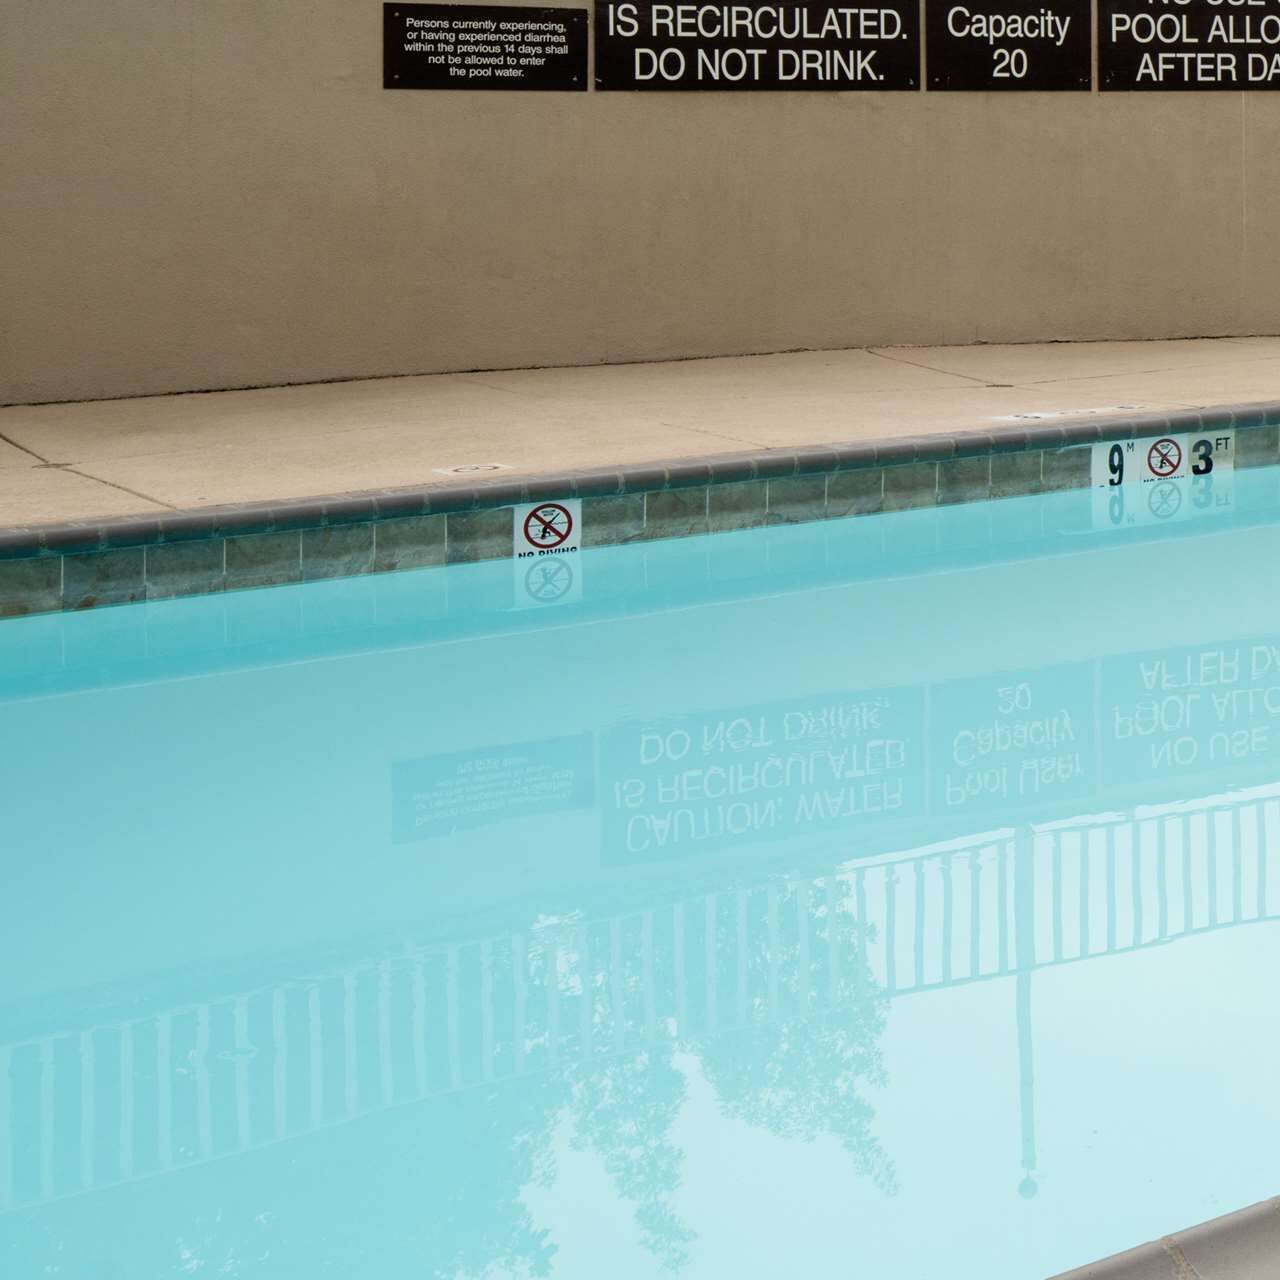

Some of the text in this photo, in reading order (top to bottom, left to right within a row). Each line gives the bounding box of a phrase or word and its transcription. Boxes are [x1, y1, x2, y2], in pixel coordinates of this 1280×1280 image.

[406, 17, 567, 33] Persons currently experiencing,
[608, 4, 908, 39] IS RECIRCULATED.
[947, 6, 1071, 46] Capacity
[1111, 13, 1199, 43] POOL
[404, 41, 568, 56] within the previous 14 days shall
[406, 30, 566, 43] or having experienced diarrhea
[428, 54, 546, 65] not be allowed to enter
[449, 66, 525, 78] the pool water.
[635, 48, 884, 81] DO NOT DRINK.
[992, 48, 1028, 78] 20
[1136, 53, 1237, 82] AFTER
[1191, 437, 1231, 476] 3 FT
